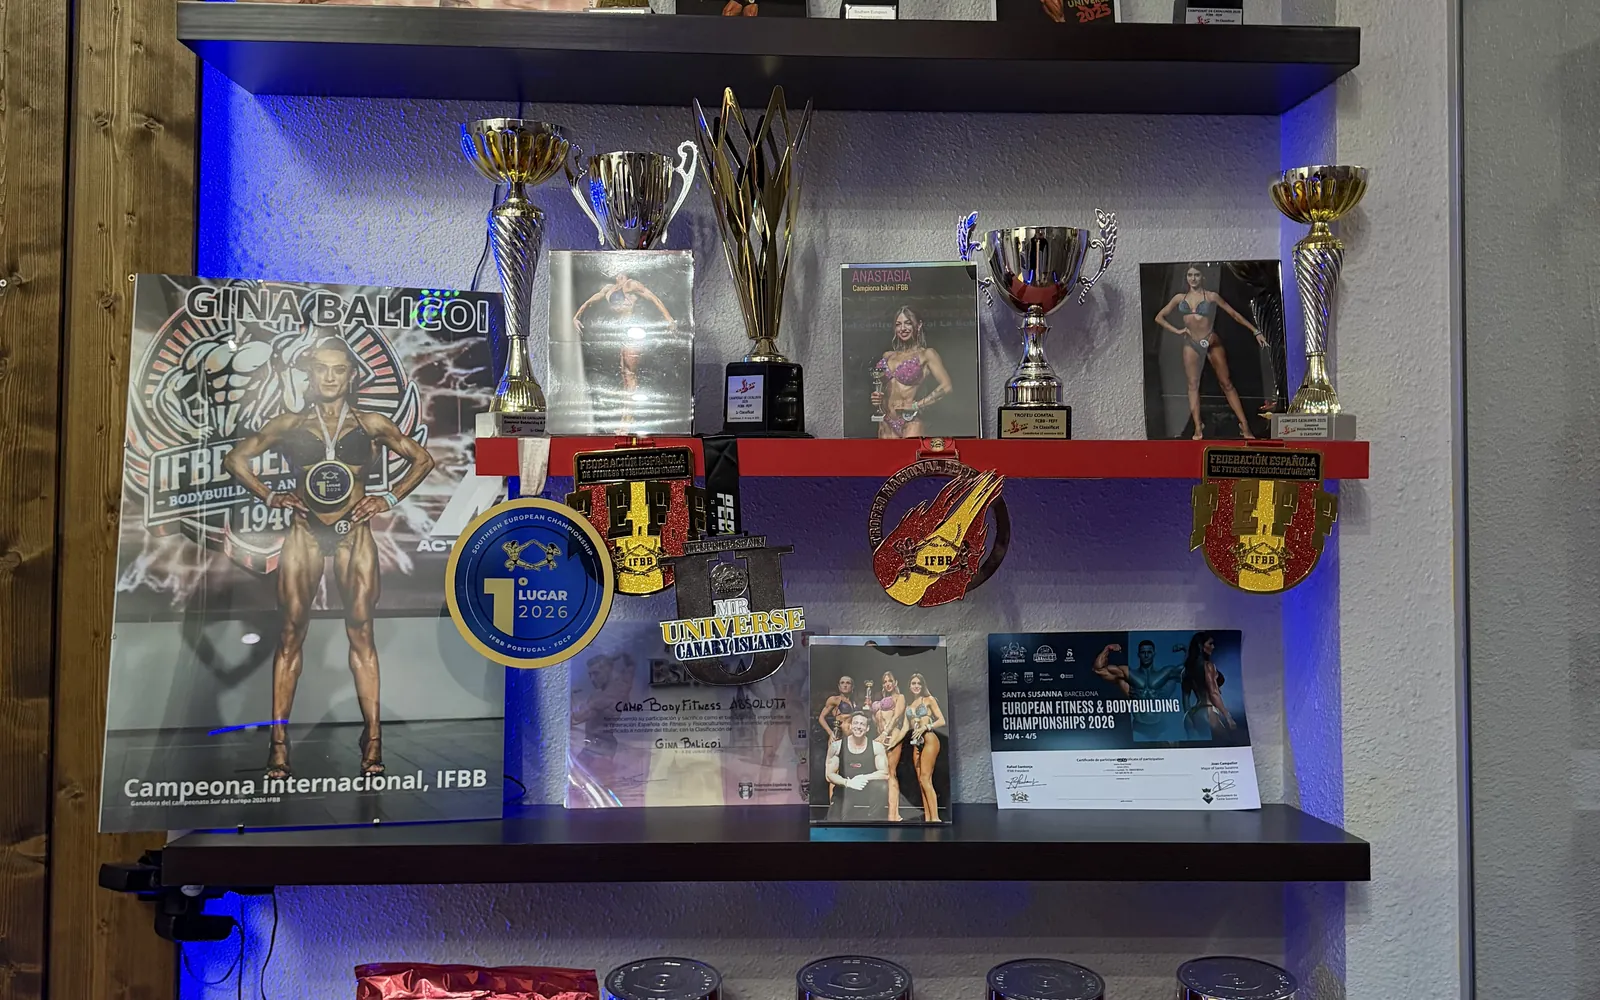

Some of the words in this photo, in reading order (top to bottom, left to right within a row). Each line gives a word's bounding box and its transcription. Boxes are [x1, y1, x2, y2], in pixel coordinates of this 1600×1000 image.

[852, 269, 912, 283] ANASTASIA
[880, 284, 895, 292] bikini
[896, 283, 909, 291] IFBB
[185, 286, 304, 325] GINA
[313, 293, 489, 333] BALICOI
[1210, 453, 1269, 466] FEDERACIÓN
[1269, 454, 1317, 467] ESPAÑOLA
[869, 496, 888, 545] TROFEO
[882, 460, 941, 498] NACIONAL
[337, 522, 349, 533] 63
[472, 522, 503, 555] SOUTHERN
[504, 513, 546, 526] EUROPEAN
[547, 516, 594, 557] CHAMPIONSHIP
[628, 556, 653, 567] IFBB
[924, 555, 953, 566] IFBB
[1250, 555, 1275, 565] IFBB
[518, 589, 568, 601] LUGAR
[518, 605, 569, 619] 2026
[714, 599, 750, 618] MR
[660, 608, 806, 645] UNIVERSE
[488, 633, 505, 647] IFBB
[506, 643, 547, 653] PORTUGAL
[553, 634, 573, 648] FDCP
[675, 637, 732, 661] CANARY
[732, 630, 793, 657] ISLANDS
[1002, 700, 1052, 715] EUROPEAN
[1056, 700, 1095, 715] FITNESS
[1096, 700, 1103, 714] &
[1106, 698, 1180, 714] BODYBUILDING
[1002, 715, 1086, 731] CHAMPIONSHIPS
[1088, 715, 1115, 729] 2026
[1025, 732, 1037, 740] 4/5
[124, 778, 255, 802] Campeona
[263, 770, 429, 795] internacional,
[437, 769, 488, 789] IFBB
